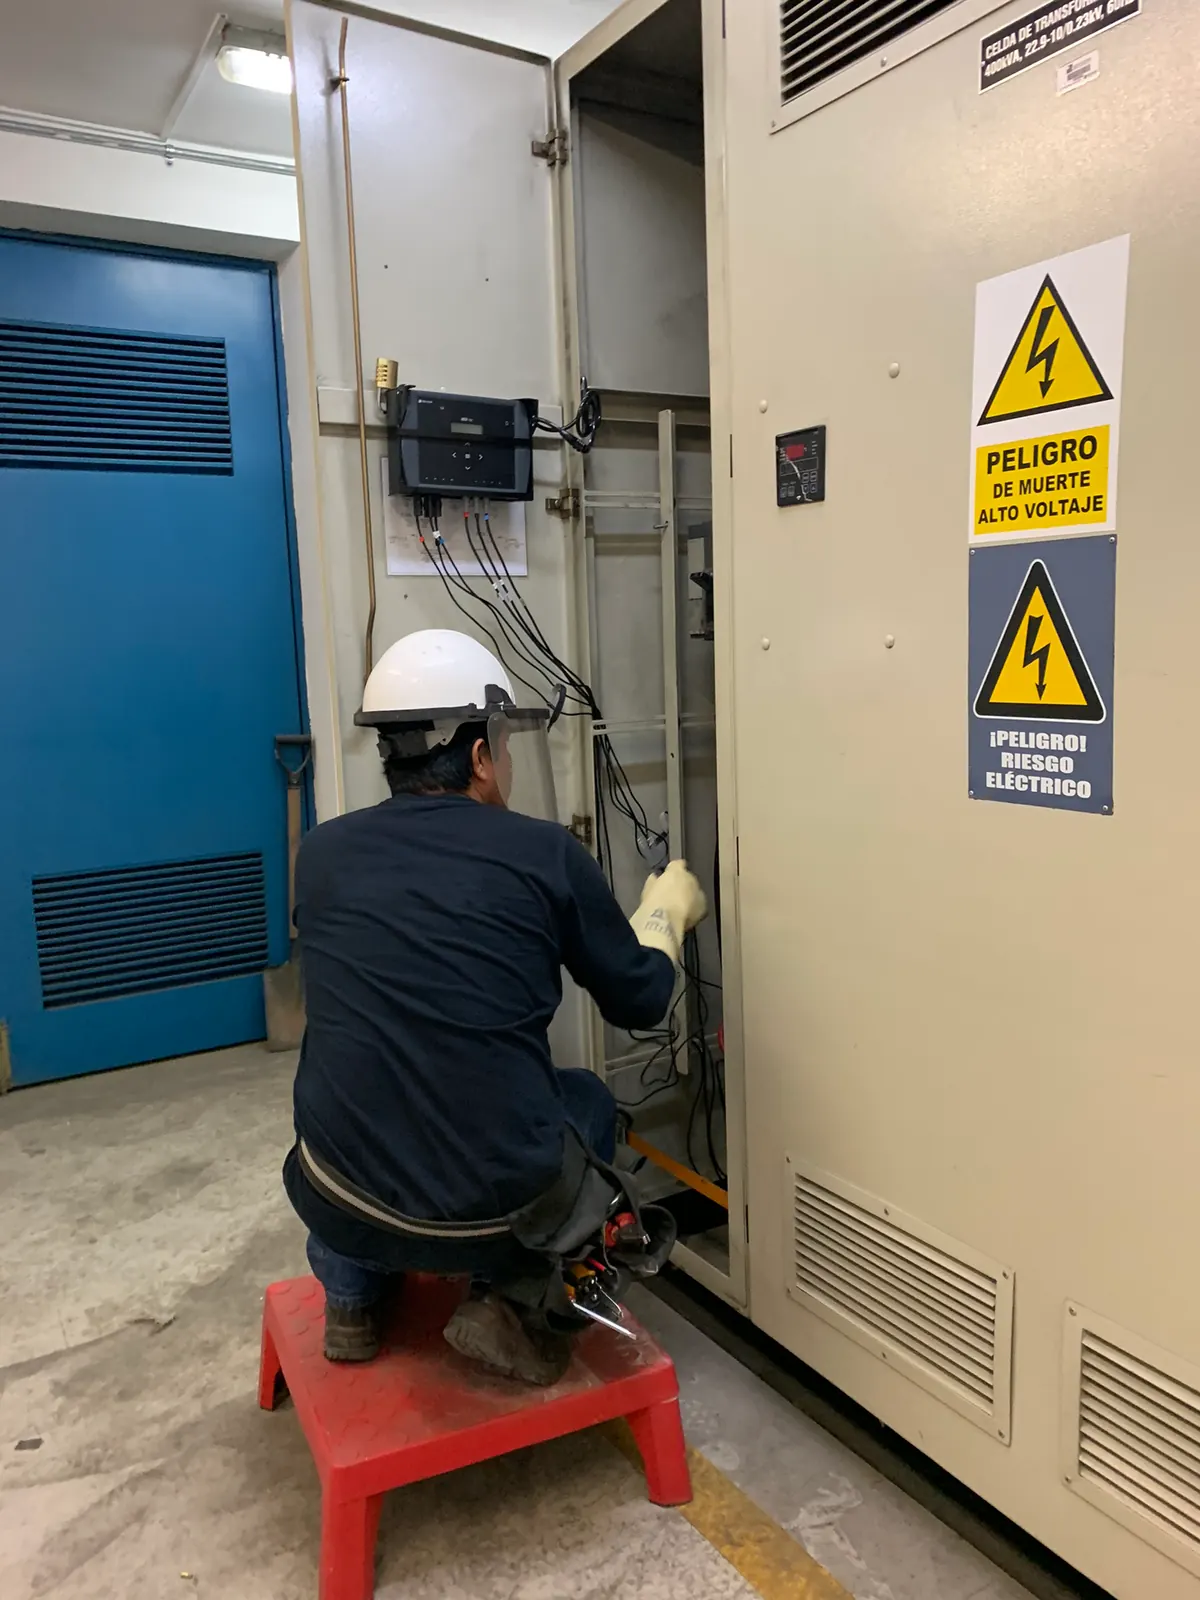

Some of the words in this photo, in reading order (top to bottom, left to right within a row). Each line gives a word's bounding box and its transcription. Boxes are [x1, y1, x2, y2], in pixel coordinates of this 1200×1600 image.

[986, 33, 1016, 59] CELDA
[1018, 24, 1032, 42] DE
[984, 50, 1022, 77] 400kVA,
[987, 435, 1097, 474] PELIGRO
[993, 481, 1013, 498] DE
[1019, 470, 1090, 495] MUERTE
[978, 505, 1018, 524] ALTO
[1025, 495, 1103, 518] VOLTAJE
[990, 730, 1086, 752] ¡PELIGRO!
[1001, 751, 1074, 774] RIESGO
[985, 770, 1091, 798] ELÉCTRICO
